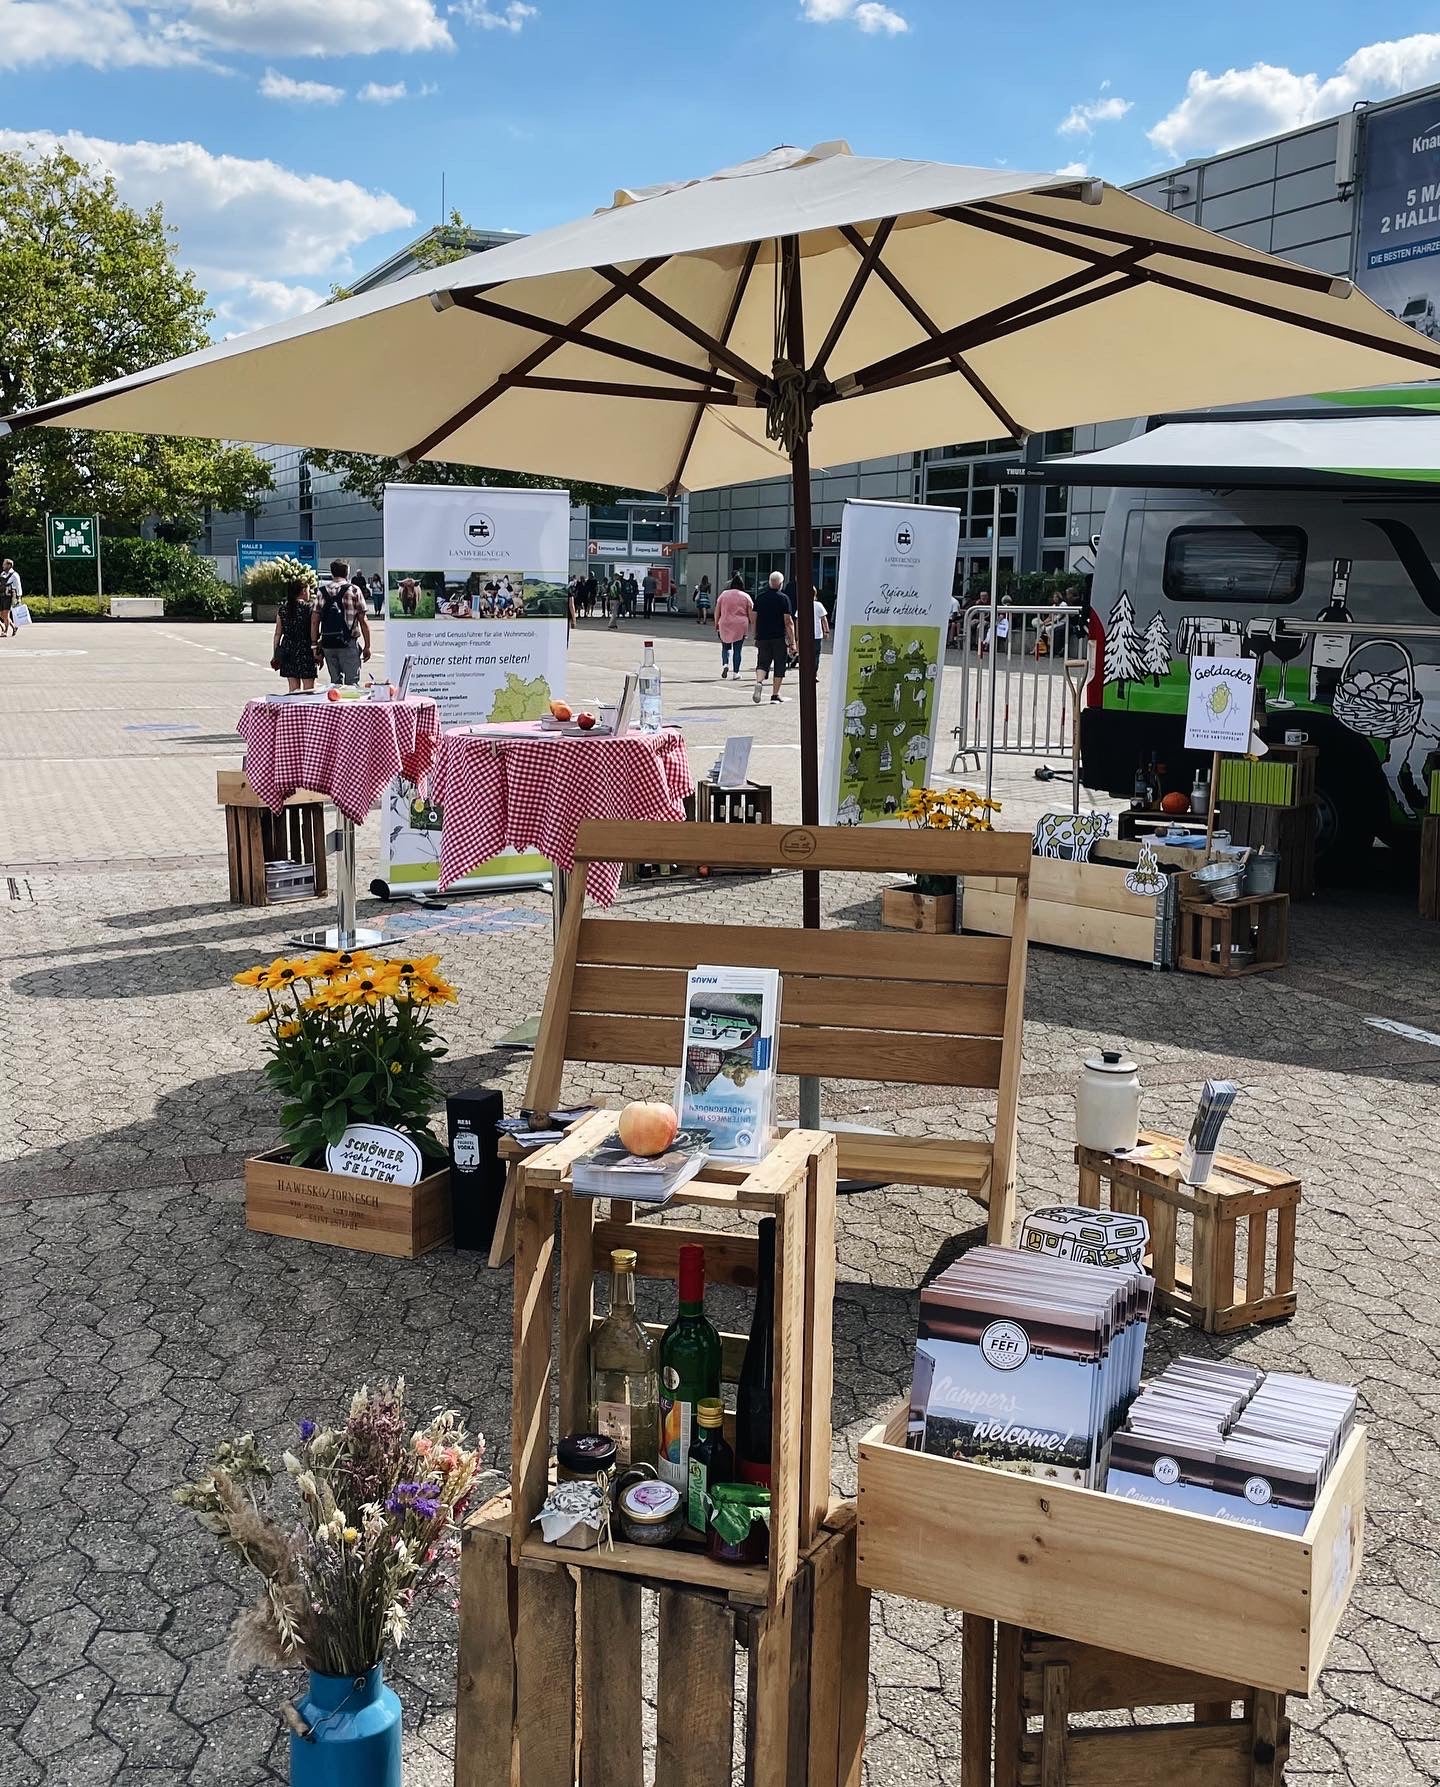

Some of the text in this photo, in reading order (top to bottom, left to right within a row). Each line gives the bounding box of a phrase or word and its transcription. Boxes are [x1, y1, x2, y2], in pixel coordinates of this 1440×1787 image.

[1407, 189, 1416, 207] 5
[1380, 216, 1391, 234] 2
[1370, 254, 1383, 265] DIE
[1384, 248, 1411, 262] BESTEN
[1006, 468, 1026, 476] THULE
[447, 654, 473, 666] steht
[474, 655, 497, 665] man
[498, 653, 532, 665] selten!
[1194, 664, 1253, 685] Goldacker
[690, 976, 718, 984] KNAUS
[345, 1137, 405, 1163] SCHÖNER
[340, 1151, 402, 1172] steht man
[342, 1161, 396, 1183] SELTEN
[991, 1339, 1019, 1353] FEFI
[933, 1375, 1023, 1414] Campers
[972, 1415, 1075, 1452] welcome!
[1158, 1466, 1174, 1475] FEFI
[1249, 1486, 1265, 1496] FEFI
